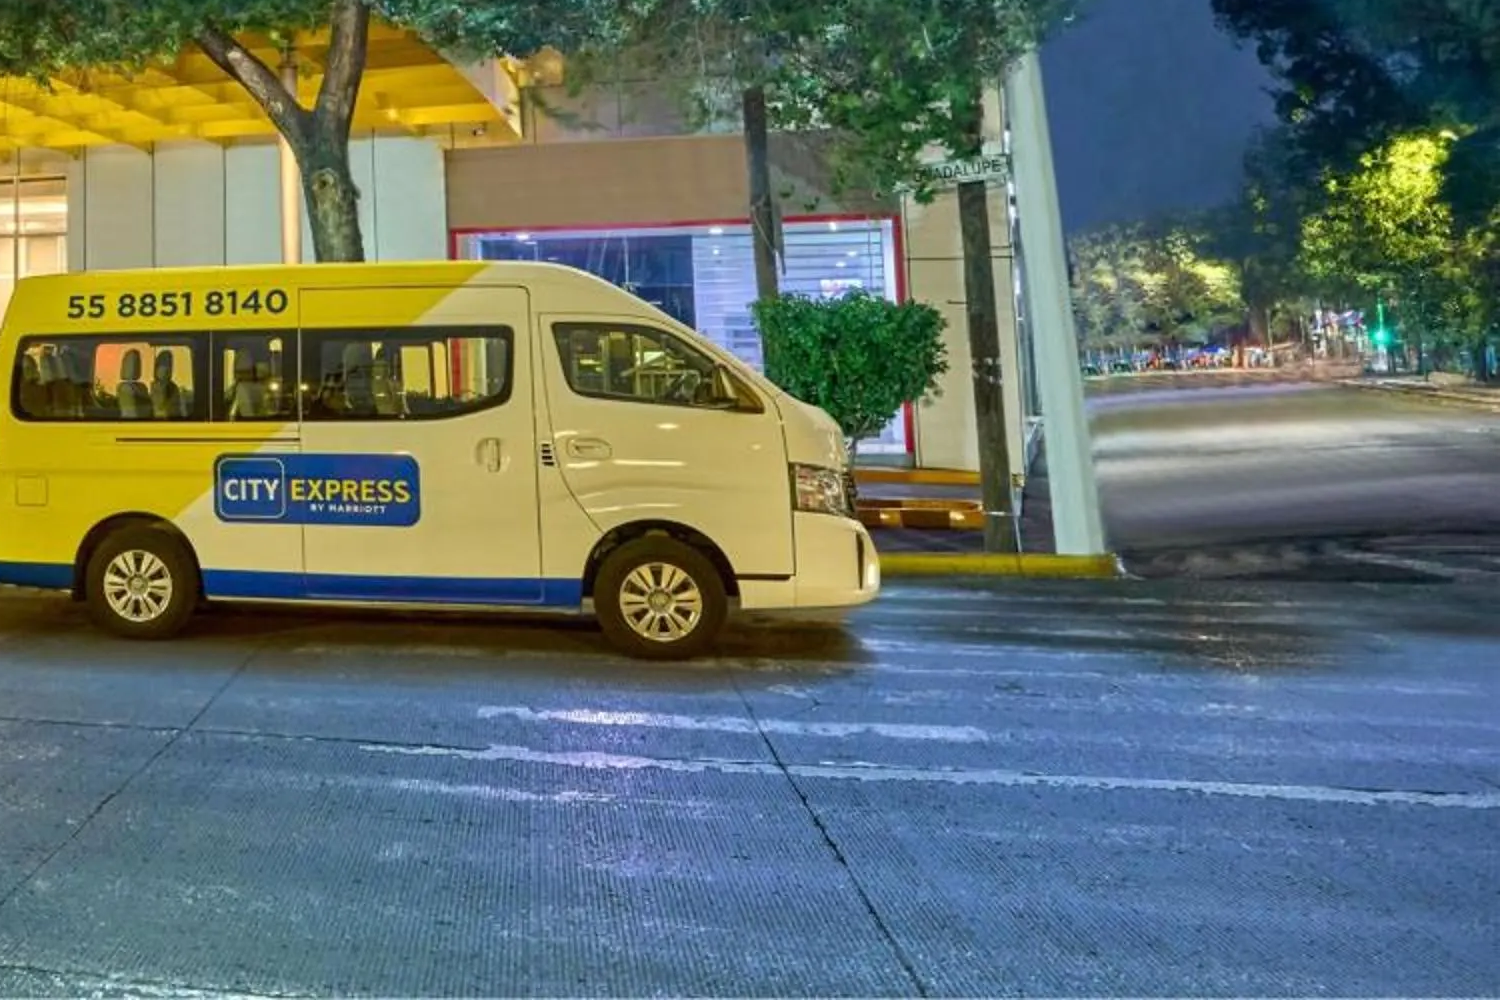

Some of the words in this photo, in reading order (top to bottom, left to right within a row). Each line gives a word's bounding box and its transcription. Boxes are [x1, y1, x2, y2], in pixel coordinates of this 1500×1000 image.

[67, 295, 105, 319] 55
[117, 292, 192, 318] 8851
[204, 289, 288, 315] 8140
[224, 478, 279, 501] CITY
[290, 479, 411, 503] EXPRESS
[309, 503, 325, 513] BY
[329, 503, 388, 514] MARRIOTT
